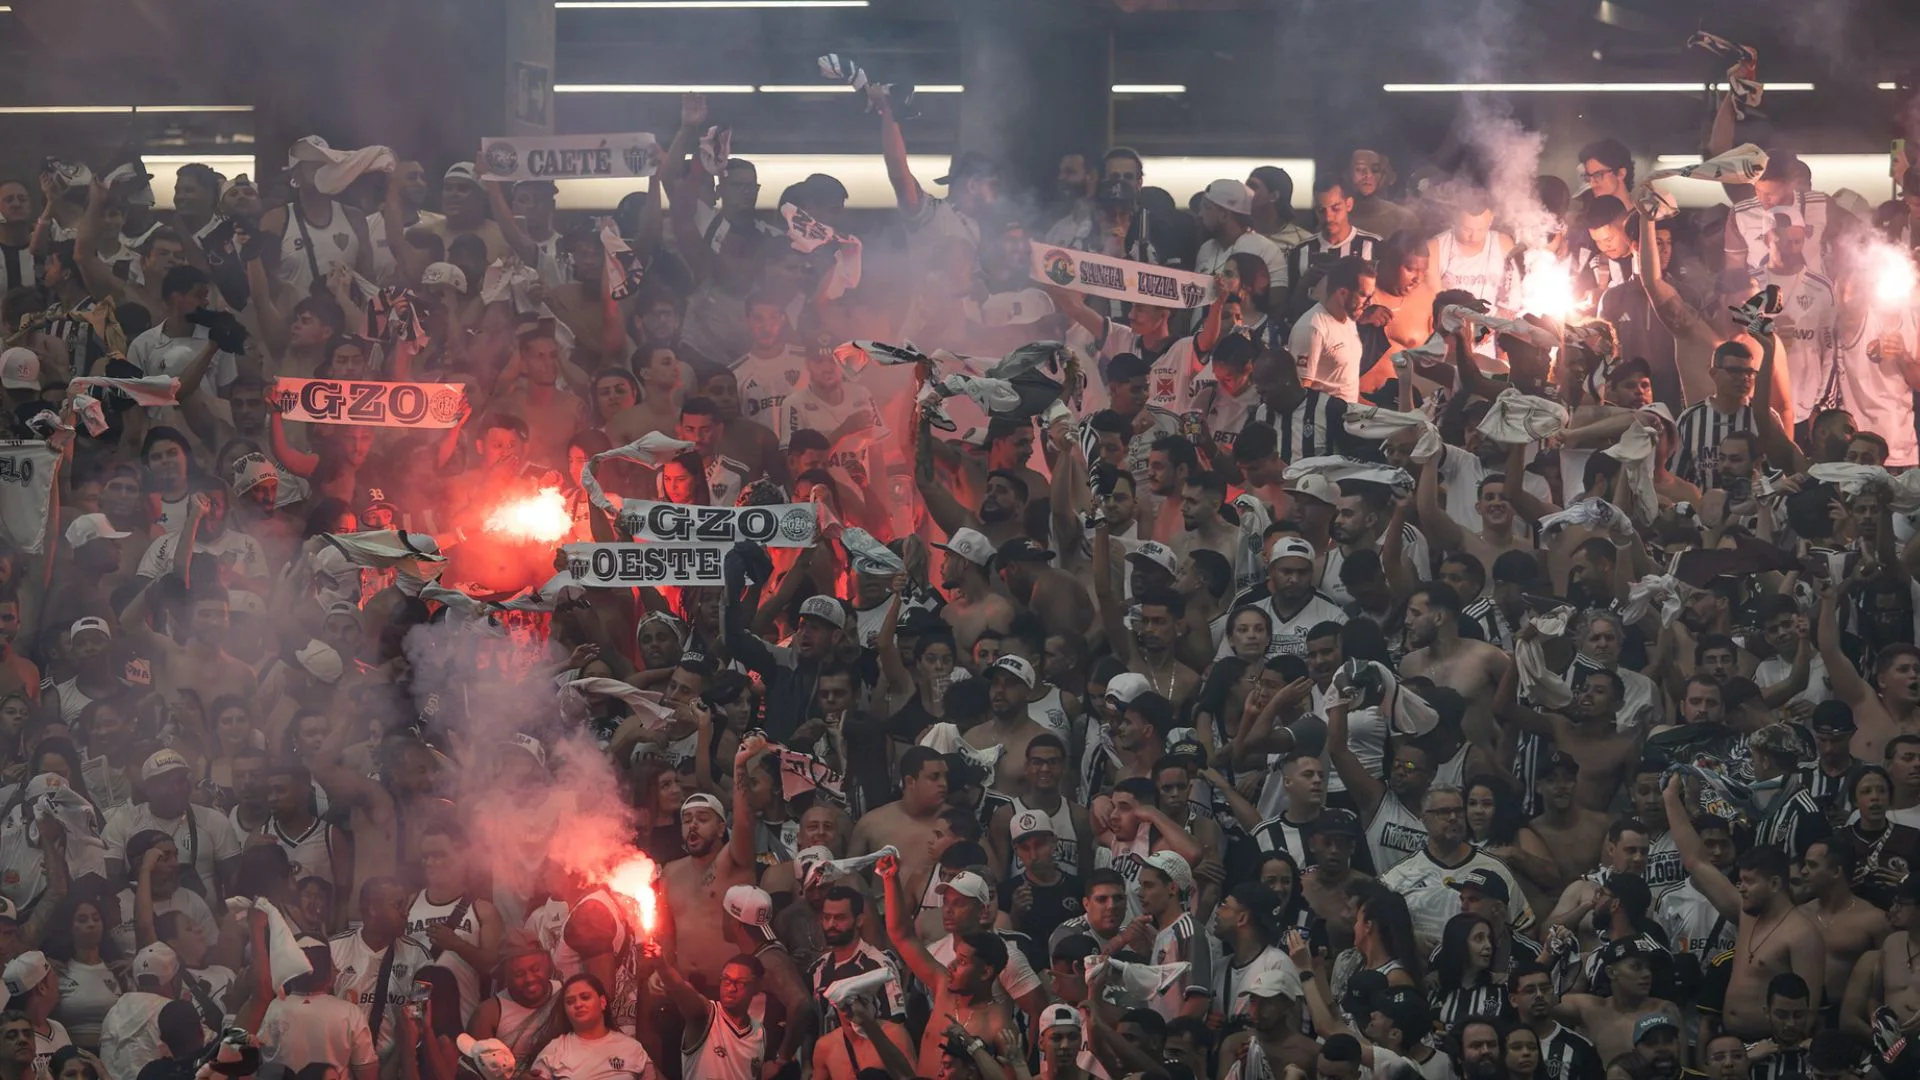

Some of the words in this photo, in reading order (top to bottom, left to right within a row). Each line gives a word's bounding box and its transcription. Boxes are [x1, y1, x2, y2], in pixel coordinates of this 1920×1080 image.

[526, 141, 612, 176] CAETÉ
[300, 381, 428, 424] GZO
[646, 502, 779, 546] GZO
[591, 547, 724, 580] OESTE
[1690, 938, 1735, 951] BEANO
[360, 992, 406, 1006] BENO
